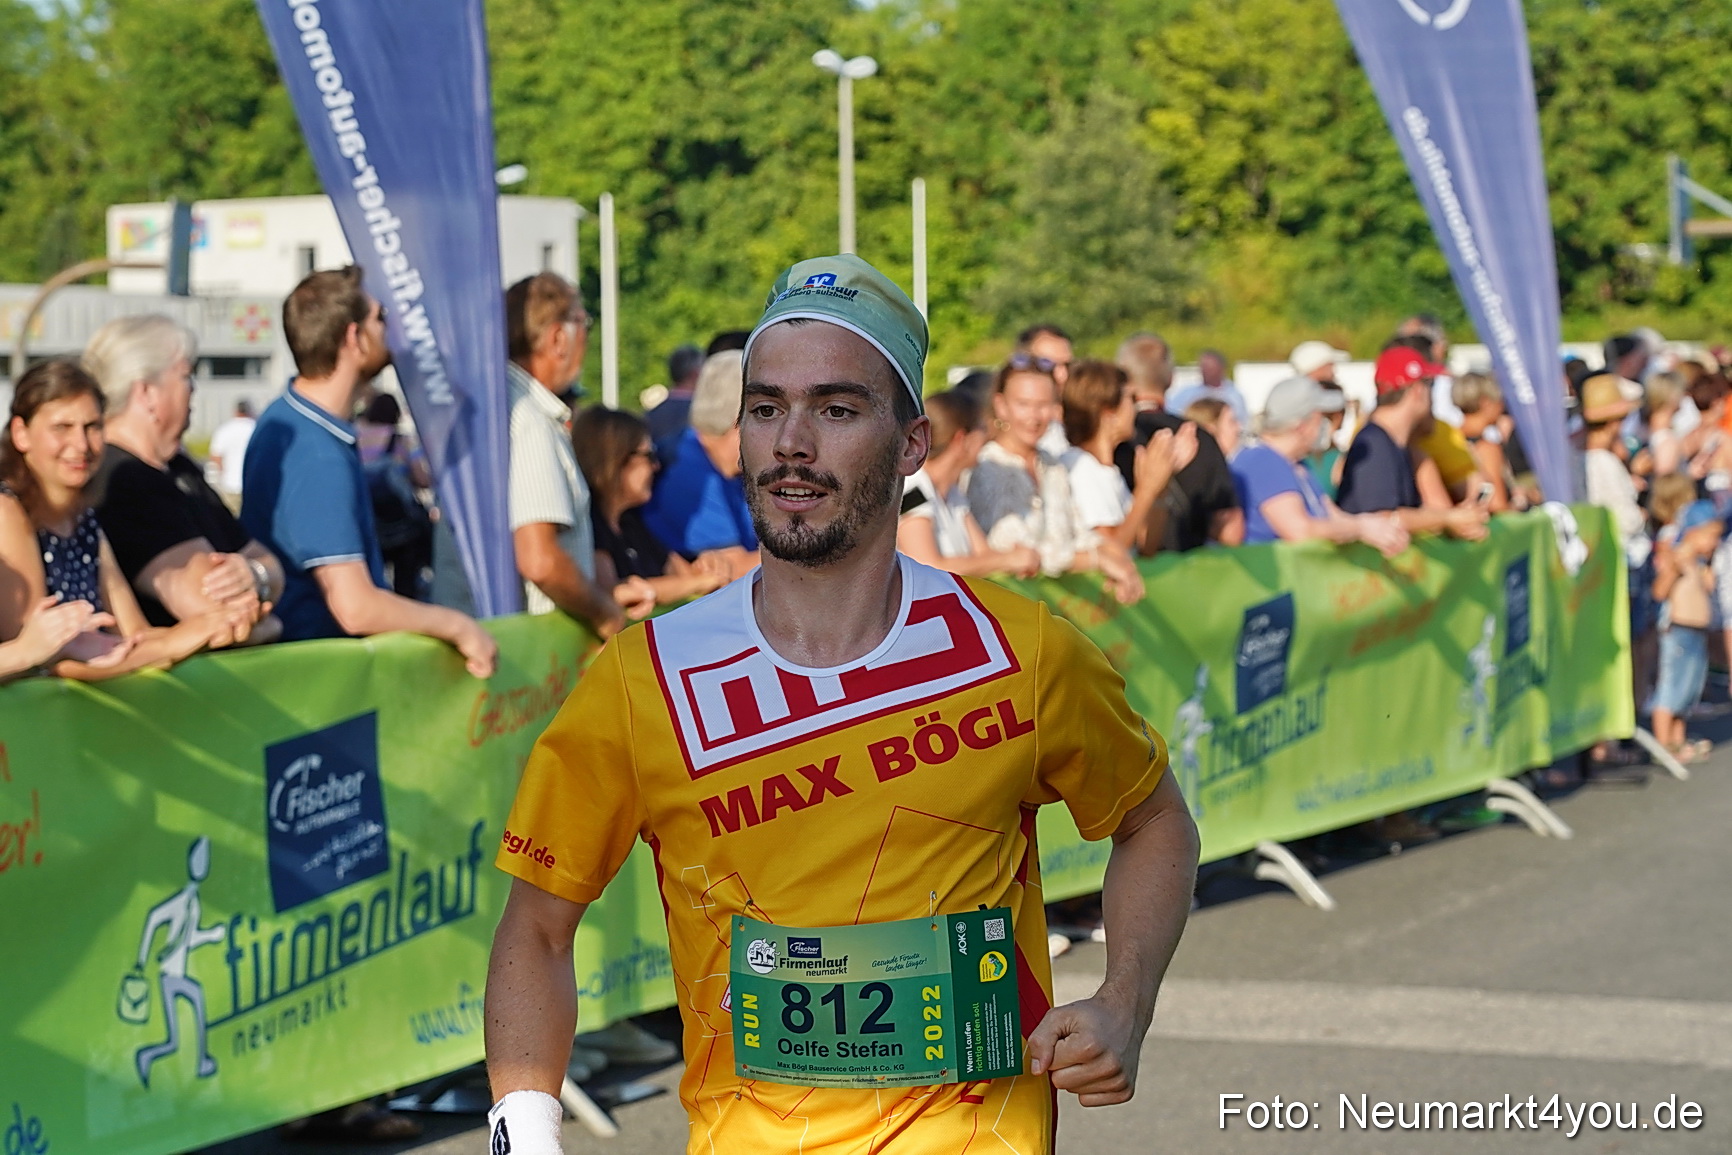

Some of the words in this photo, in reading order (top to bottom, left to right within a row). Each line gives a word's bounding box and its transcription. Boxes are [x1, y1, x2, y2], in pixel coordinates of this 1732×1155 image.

[699, 754, 854, 838] MAX
[867, 698, 1035, 783] BÖGL
[286, 770, 366, 822] Fischer
[226, 820, 485, 1017] firmenlauf
[957, 933, 967, 956] AOK
[779, 955, 849, 970] Firmenlauf
[806, 967, 848, 977] neumarkt
[232, 979, 348, 1057] neumarkt
[742, 993, 761, 1048] RUN
[781, 982, 895, 1035] 812
[972, 1002, 980, 1018] soll
[921, 985, 944, 1061] 2022
[965, 1021, 973, 1049] Laufen
[974, 1018, 983, 1045] laufen
[777, 1038, 830, 1058] Oelfe
[836, 1040, 903, 1058] Stefan
[966, 1050, 974, 1074] Wenn
[975, 1045, 984, 1073] richtig
[777, 1061, 791, 1070] Max
[791, 1063, 808, 1072] Bögl
[809, 1064, 848, 1073] Bauservice
[848, 1064, 870, 1073] GmbH
[878, 1064, 892, 1072] Co.
[893, 1063, 905, 1071] KG
